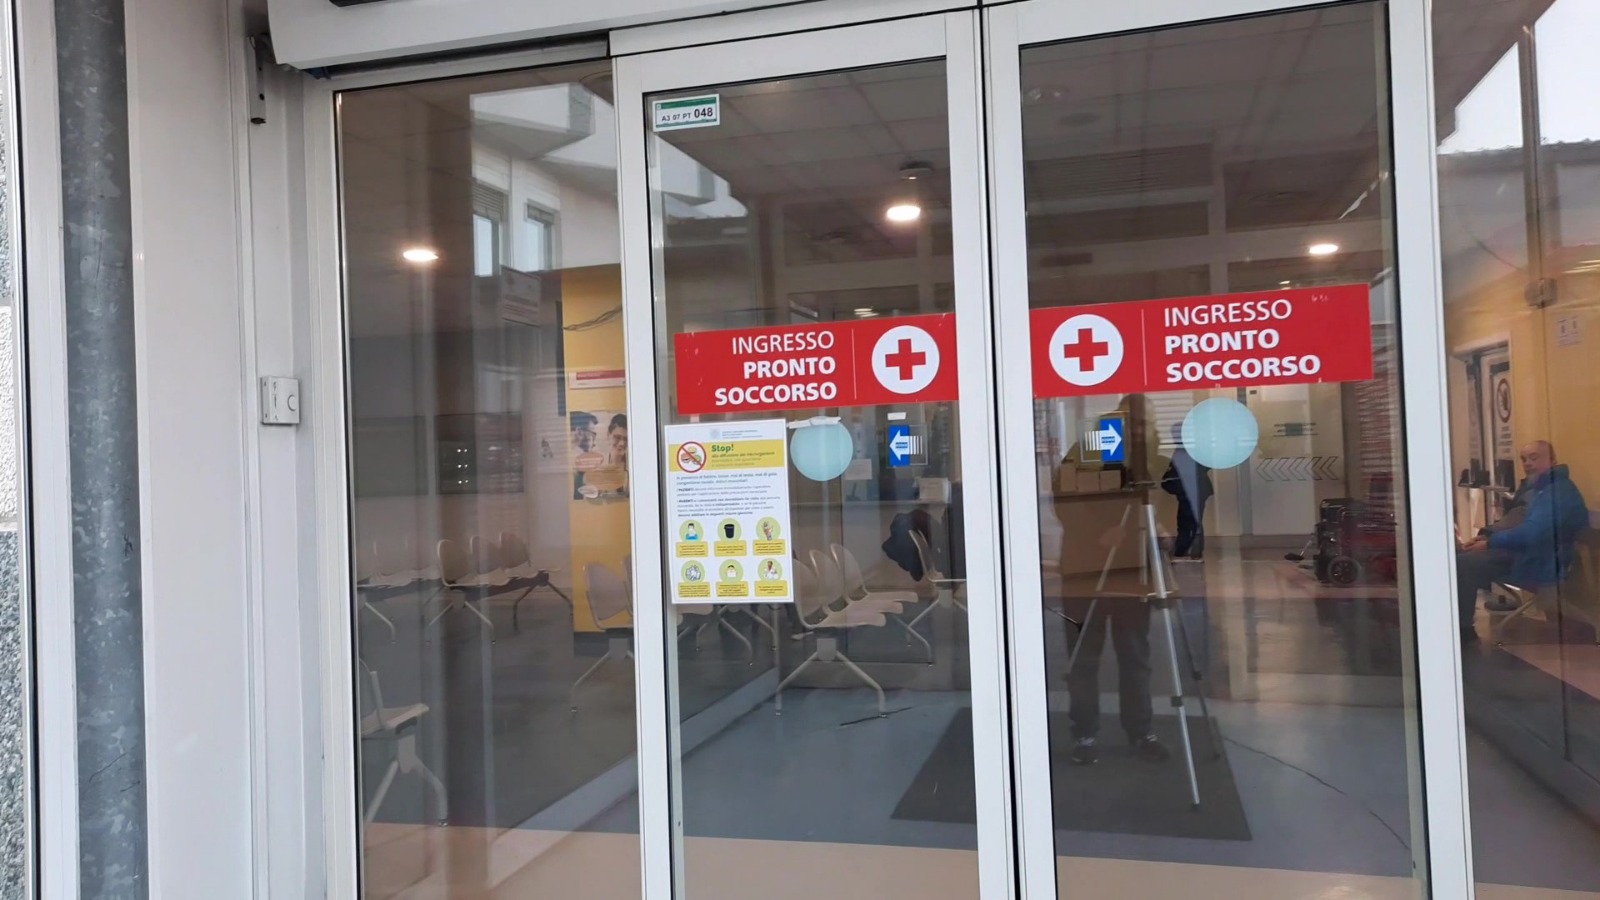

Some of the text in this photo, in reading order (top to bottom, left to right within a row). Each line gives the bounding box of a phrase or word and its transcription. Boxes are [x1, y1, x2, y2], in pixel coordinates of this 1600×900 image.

[693, 107, 713, 118] 048
[1164, 300, 1292, 327] INGRESSO
[732, 331, 835, 355] INGRESSO
[1165, 329, 1280, 355] PRONTO
[743, 357, 836, 379] PRONTO
[1166, 355, 1321, 383] SOCCORSO
[714, 382, 837, 406] SOCCORSO
[711, 444, 734, 453] Stop!
